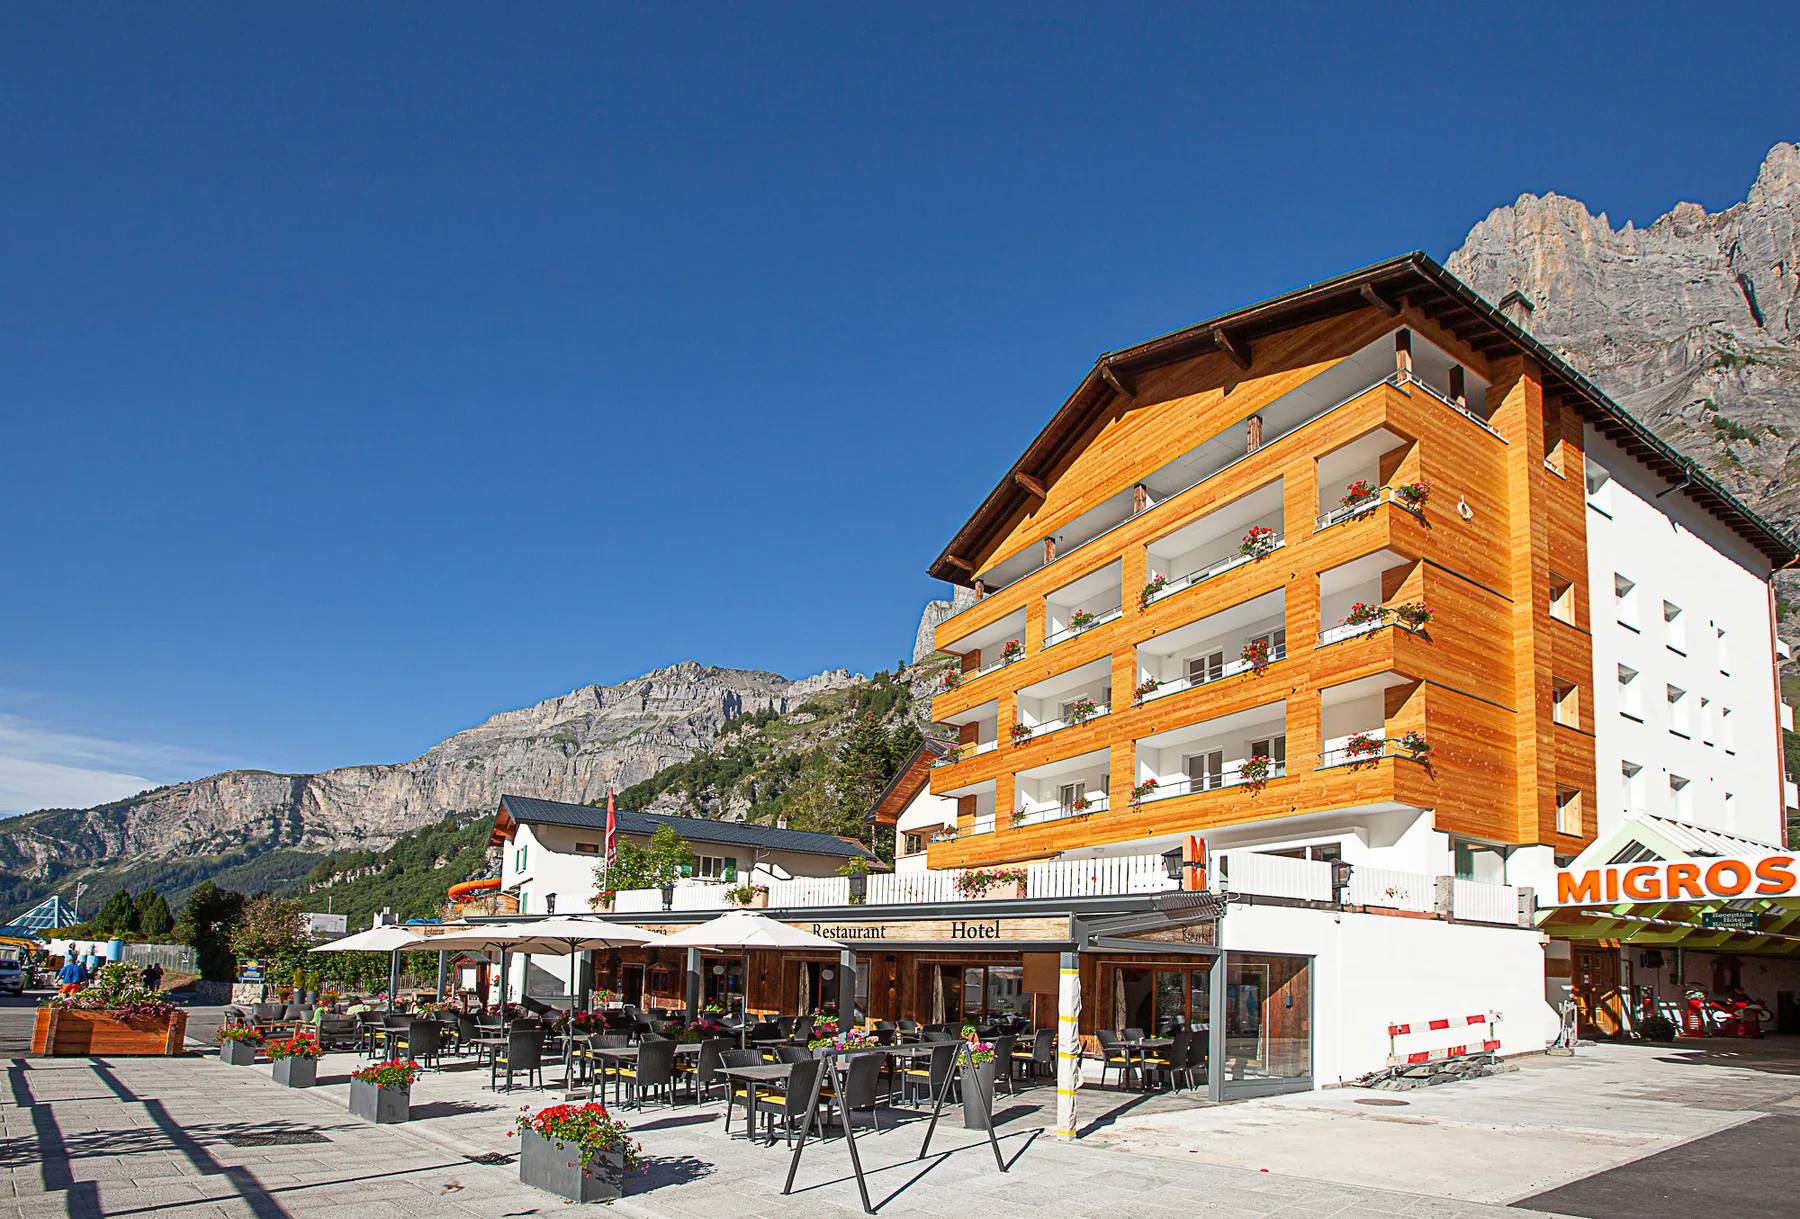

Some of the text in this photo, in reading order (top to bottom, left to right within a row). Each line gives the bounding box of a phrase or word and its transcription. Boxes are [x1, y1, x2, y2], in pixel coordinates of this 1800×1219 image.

[1556, 856, 1797, 904] MIGROS
[812, 919, 1001, 939] Restaurant Hotel
